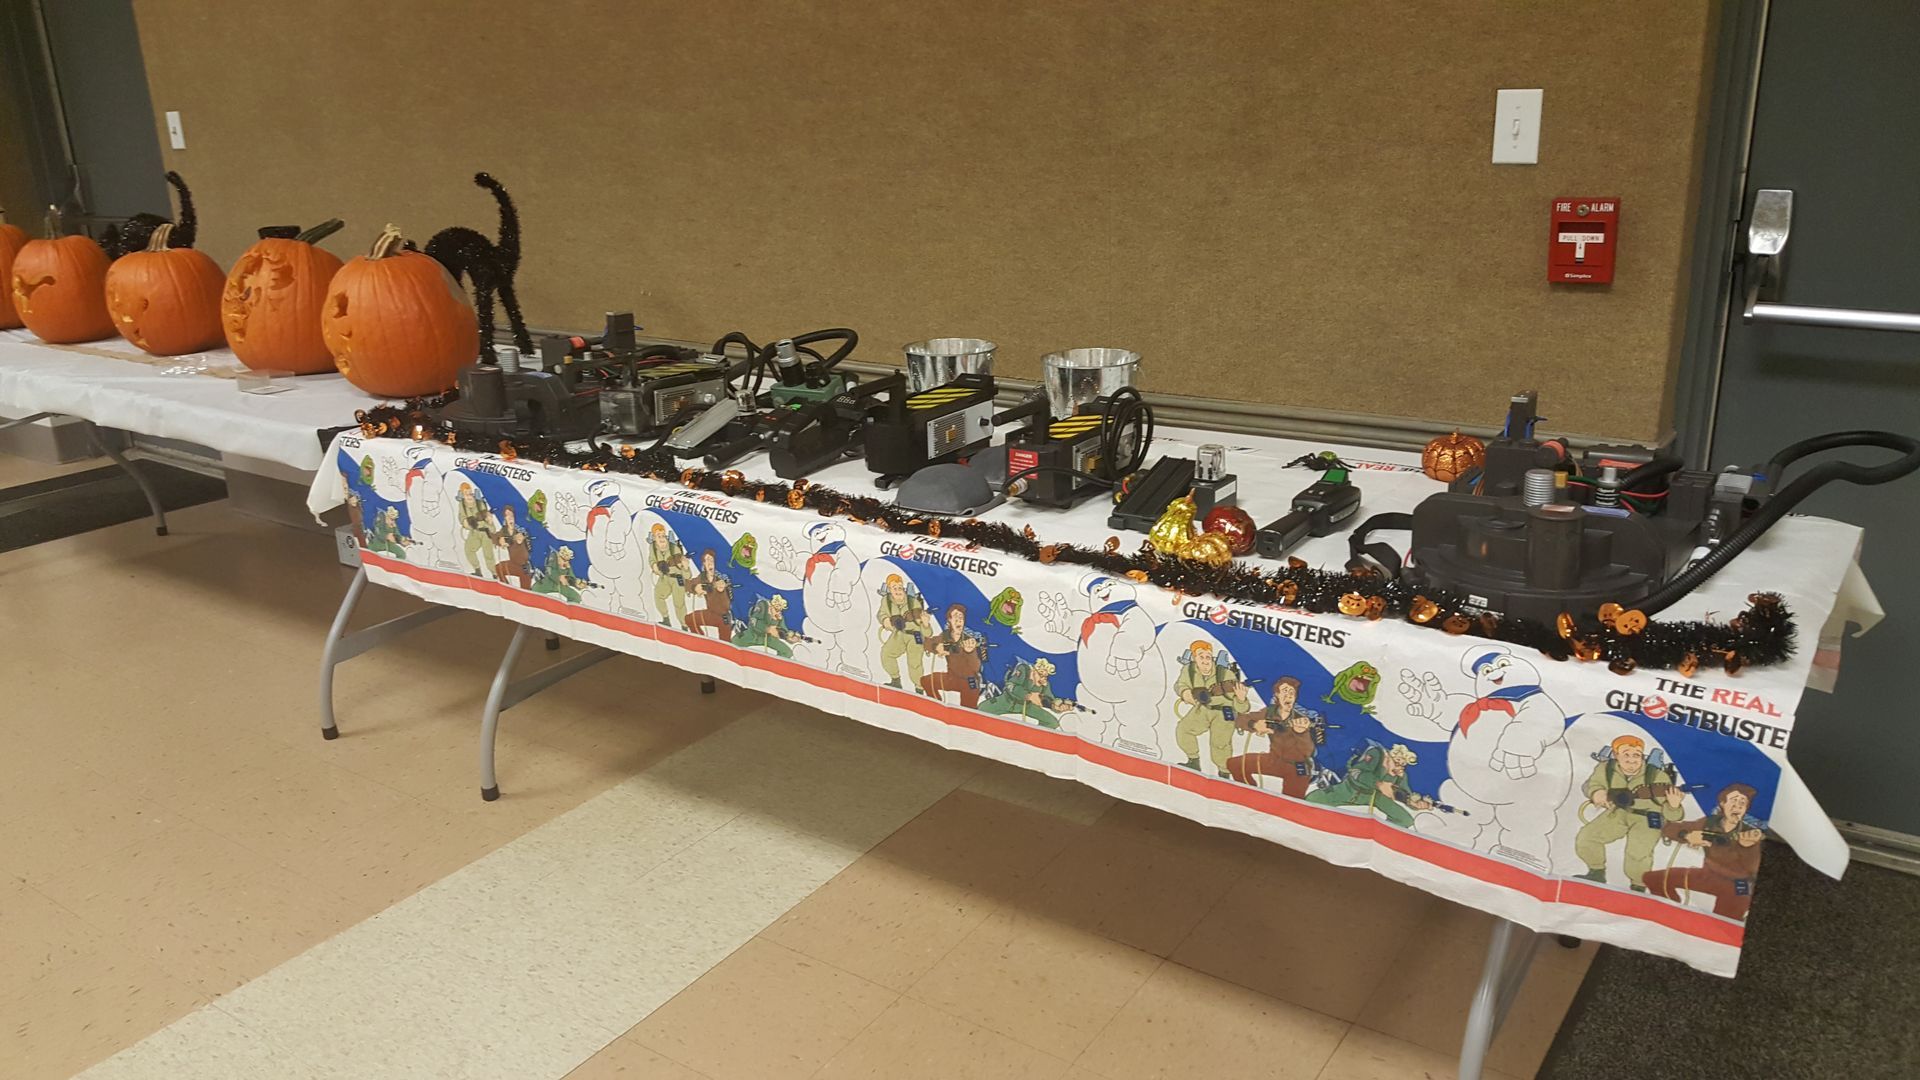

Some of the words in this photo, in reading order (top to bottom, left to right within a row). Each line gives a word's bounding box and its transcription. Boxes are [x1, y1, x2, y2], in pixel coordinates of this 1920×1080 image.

[1556, 203, 1572, 212] FIRE
[1590, 203, 1614, 212] ALARM
[455, 457, 535, 482] GHOSTBUSTERS
[645, 494, 742, 524] GHOSTBUSTERS
[673, 490, 700, 499] THE
[697, 495, 732, 507] REAL
[912, 535, 943, 546] THE
[880, 540, 999, 577] GHOSTBUSTERS
[1222, 596, 1257, 608] THE
[1182, 601, 1347, 649] GHOSTBUSTERS
[1655, 677, 1707, 700] THE
[1711, 688, 1782, 717] REAL
